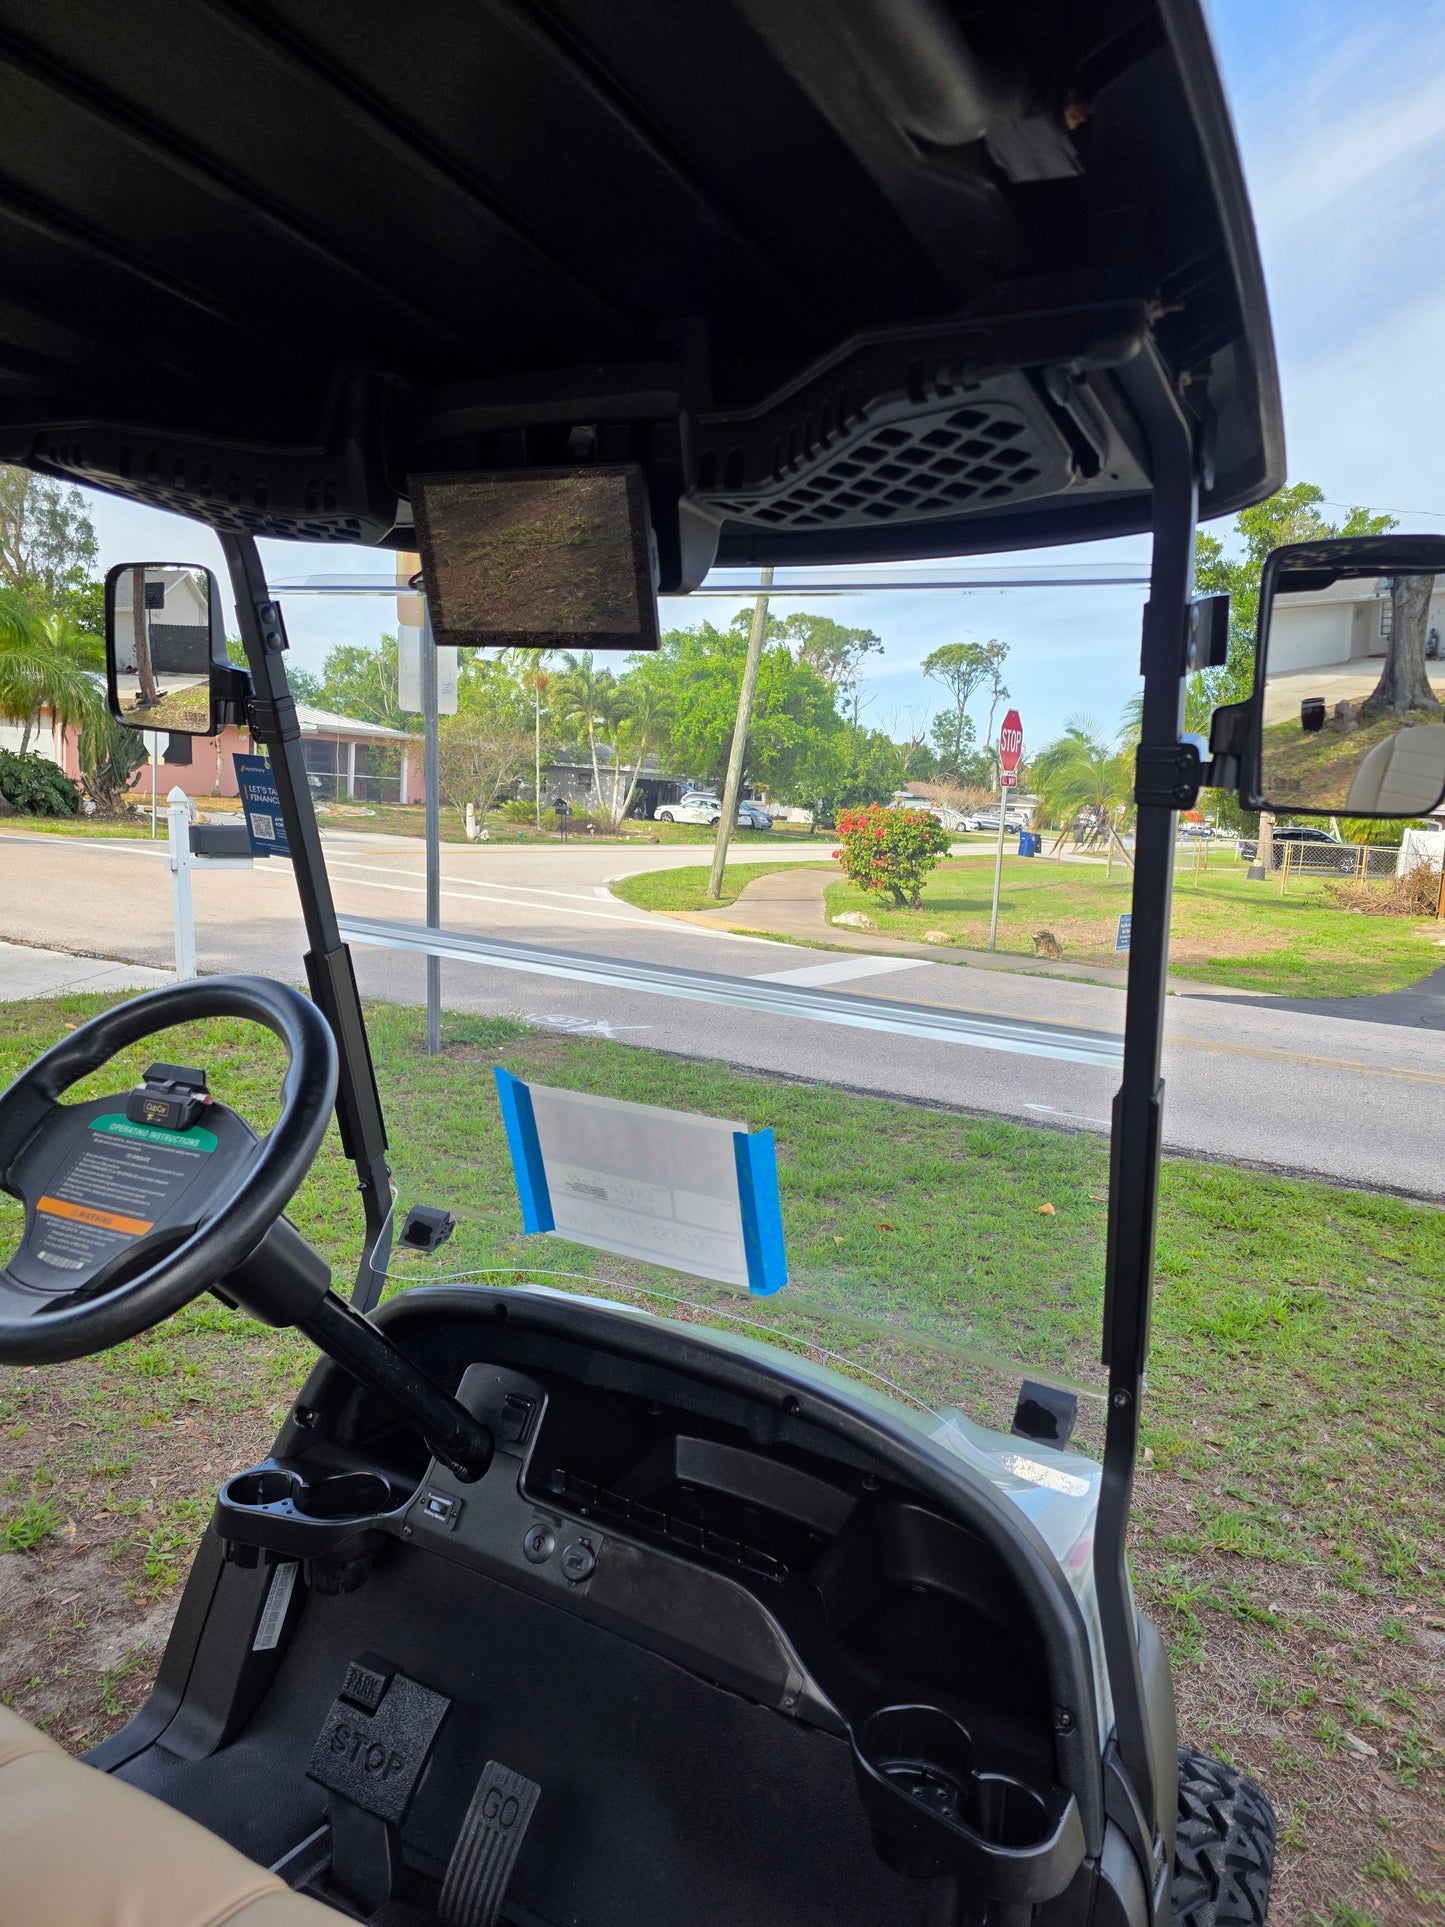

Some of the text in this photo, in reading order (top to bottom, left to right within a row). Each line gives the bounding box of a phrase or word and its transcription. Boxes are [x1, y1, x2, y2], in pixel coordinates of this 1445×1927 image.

[1001, 728, 1021, 752] STOP
[248, 785, 267, 794] LET'S
[109, 1122, 150, 1138] OPERATING
[150, 1131, 201, 1147] INSTRUCTIONS
[79, 1210, 114, 1225] WARNING
[347, 1671, 379, 1699] PARK
[330, 1723, 404, 1781] STOP
[481, 1787, 520, 1830] GO
